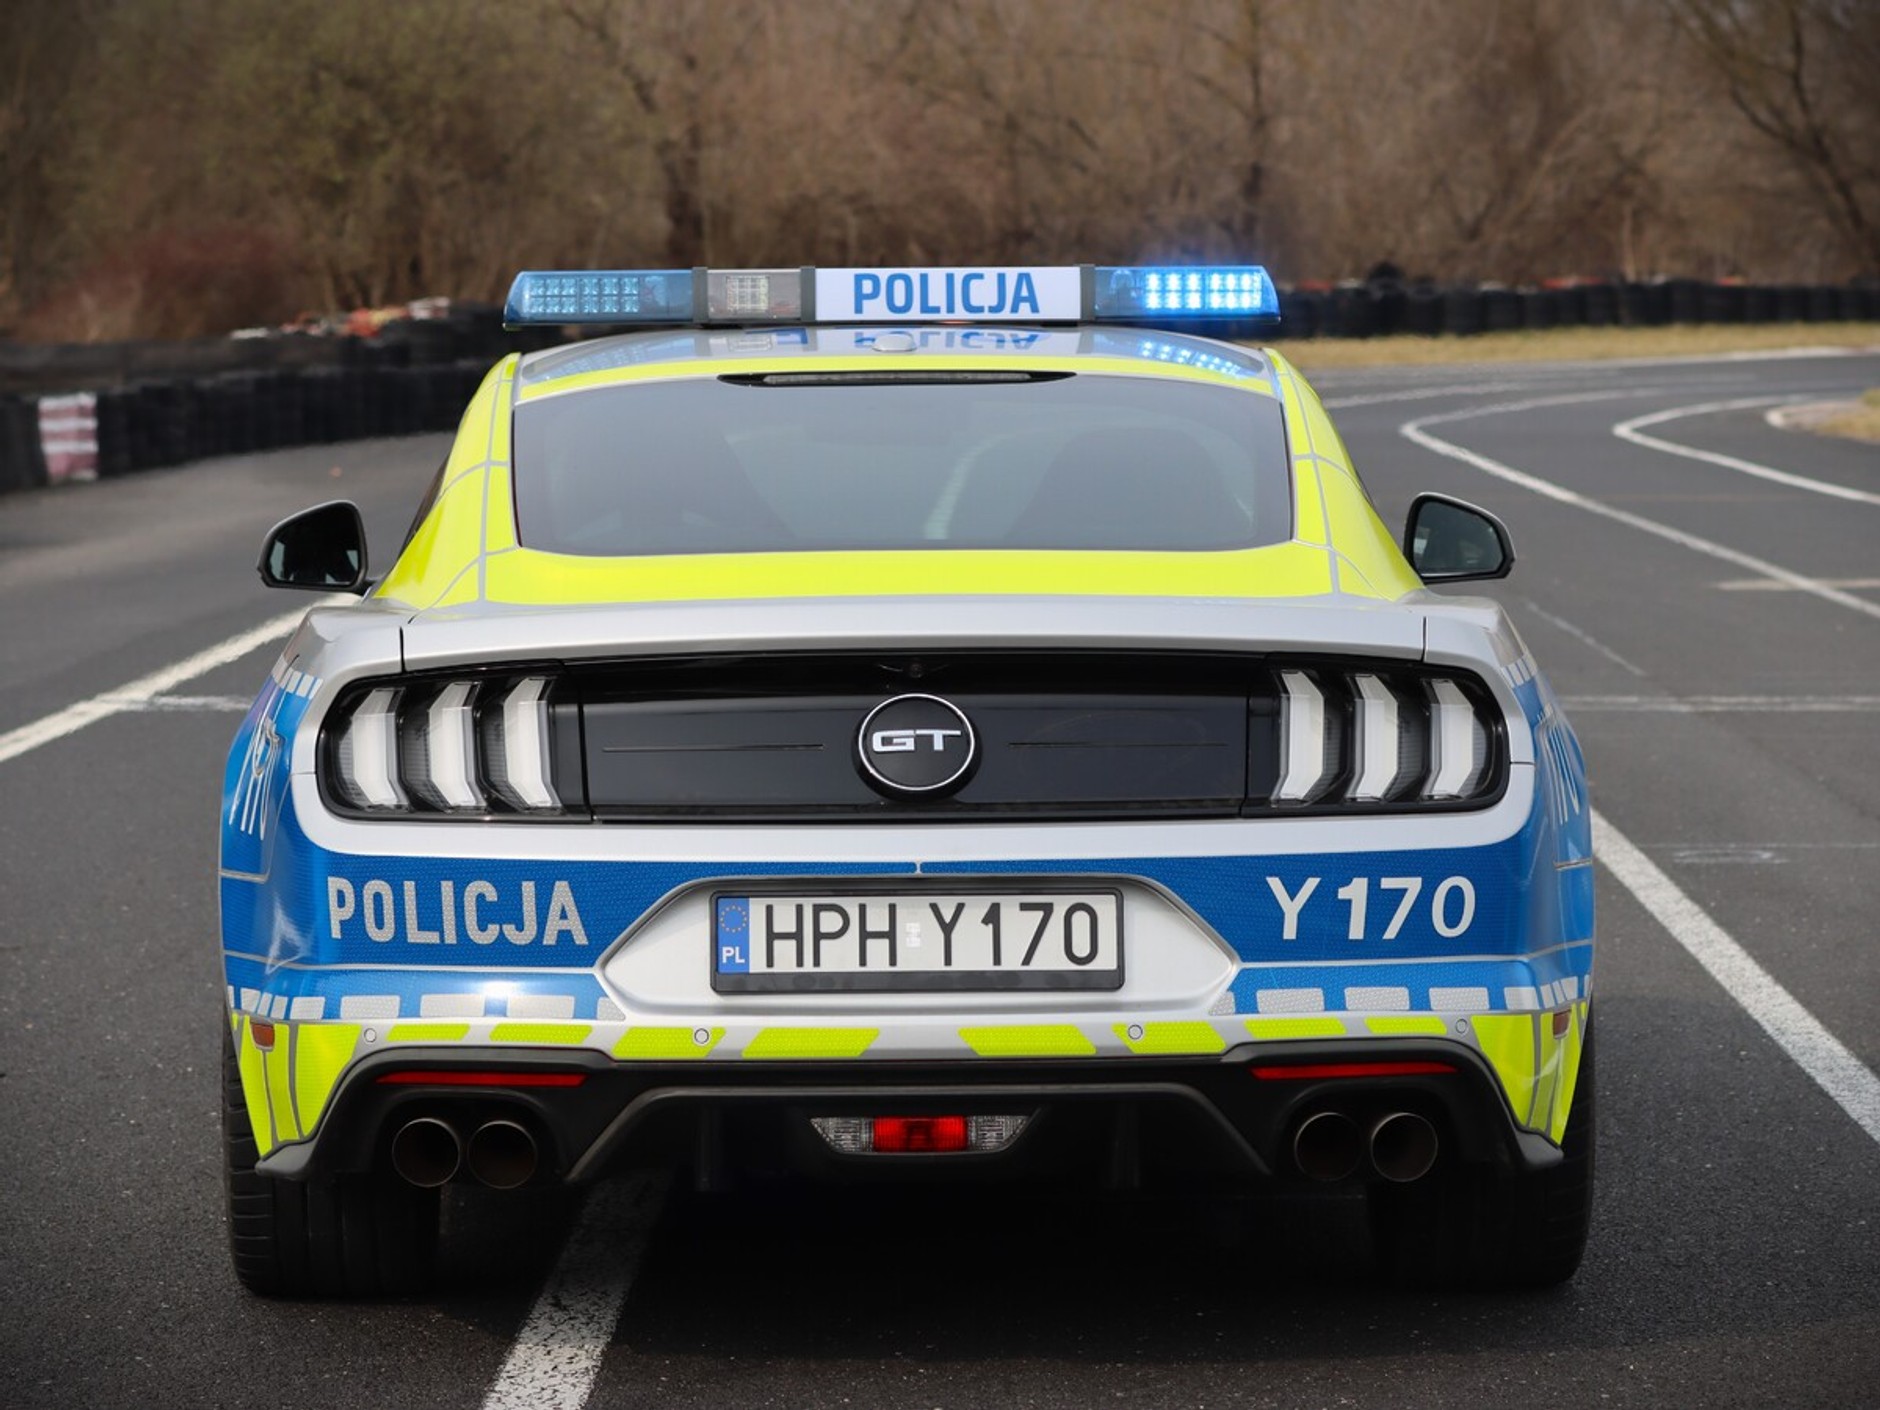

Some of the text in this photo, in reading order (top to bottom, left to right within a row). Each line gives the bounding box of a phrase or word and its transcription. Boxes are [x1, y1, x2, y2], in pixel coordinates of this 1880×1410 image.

[853, 272, 1040, 315] POLICJA
[872, 729, 962, 752] GT
[327, 876, 589, 945] POLICJA
[722, 946, 746, 964] PL
[765, 902, 1099, 968] HPH Y170
